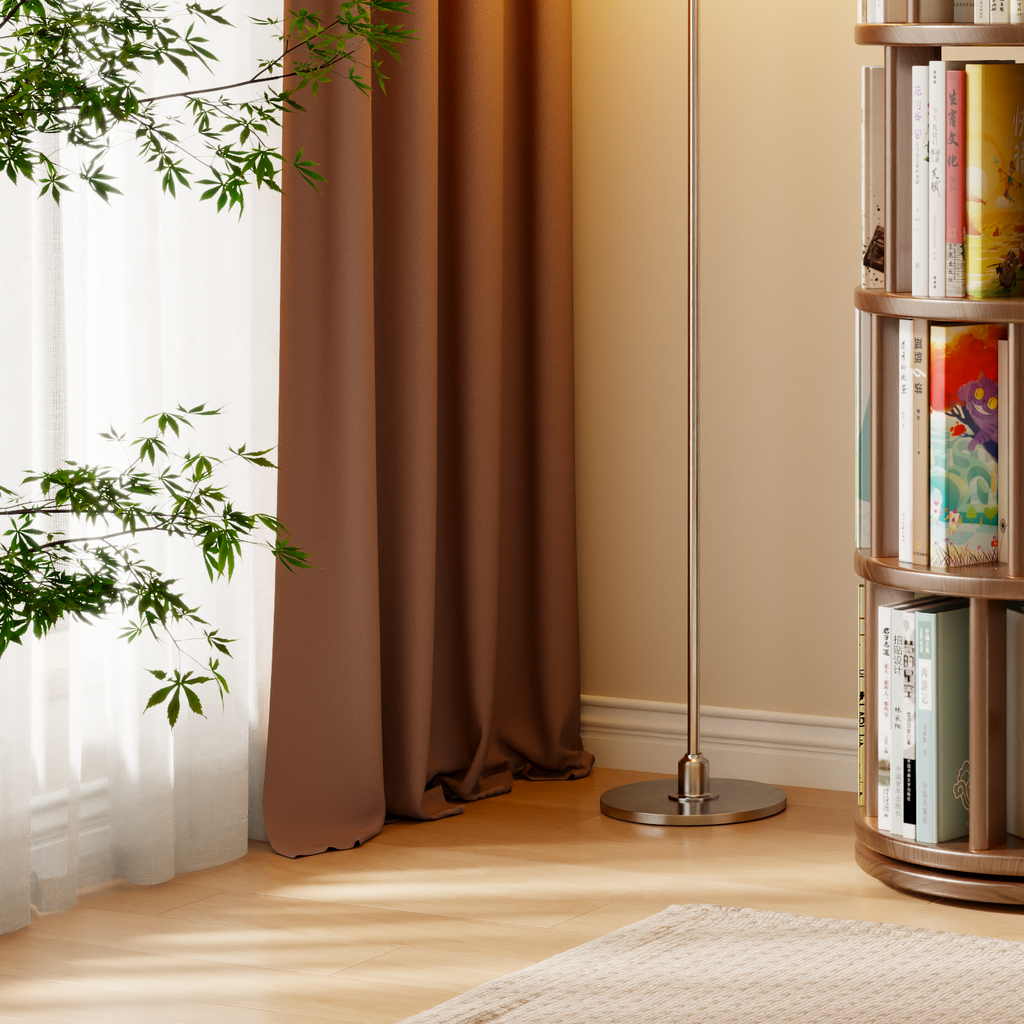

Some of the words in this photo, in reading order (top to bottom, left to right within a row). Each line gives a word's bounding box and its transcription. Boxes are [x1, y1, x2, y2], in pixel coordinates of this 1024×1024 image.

[946, 88, 959, 168] 生肖文化
[893, 635, 903, 676] 招贴设计
